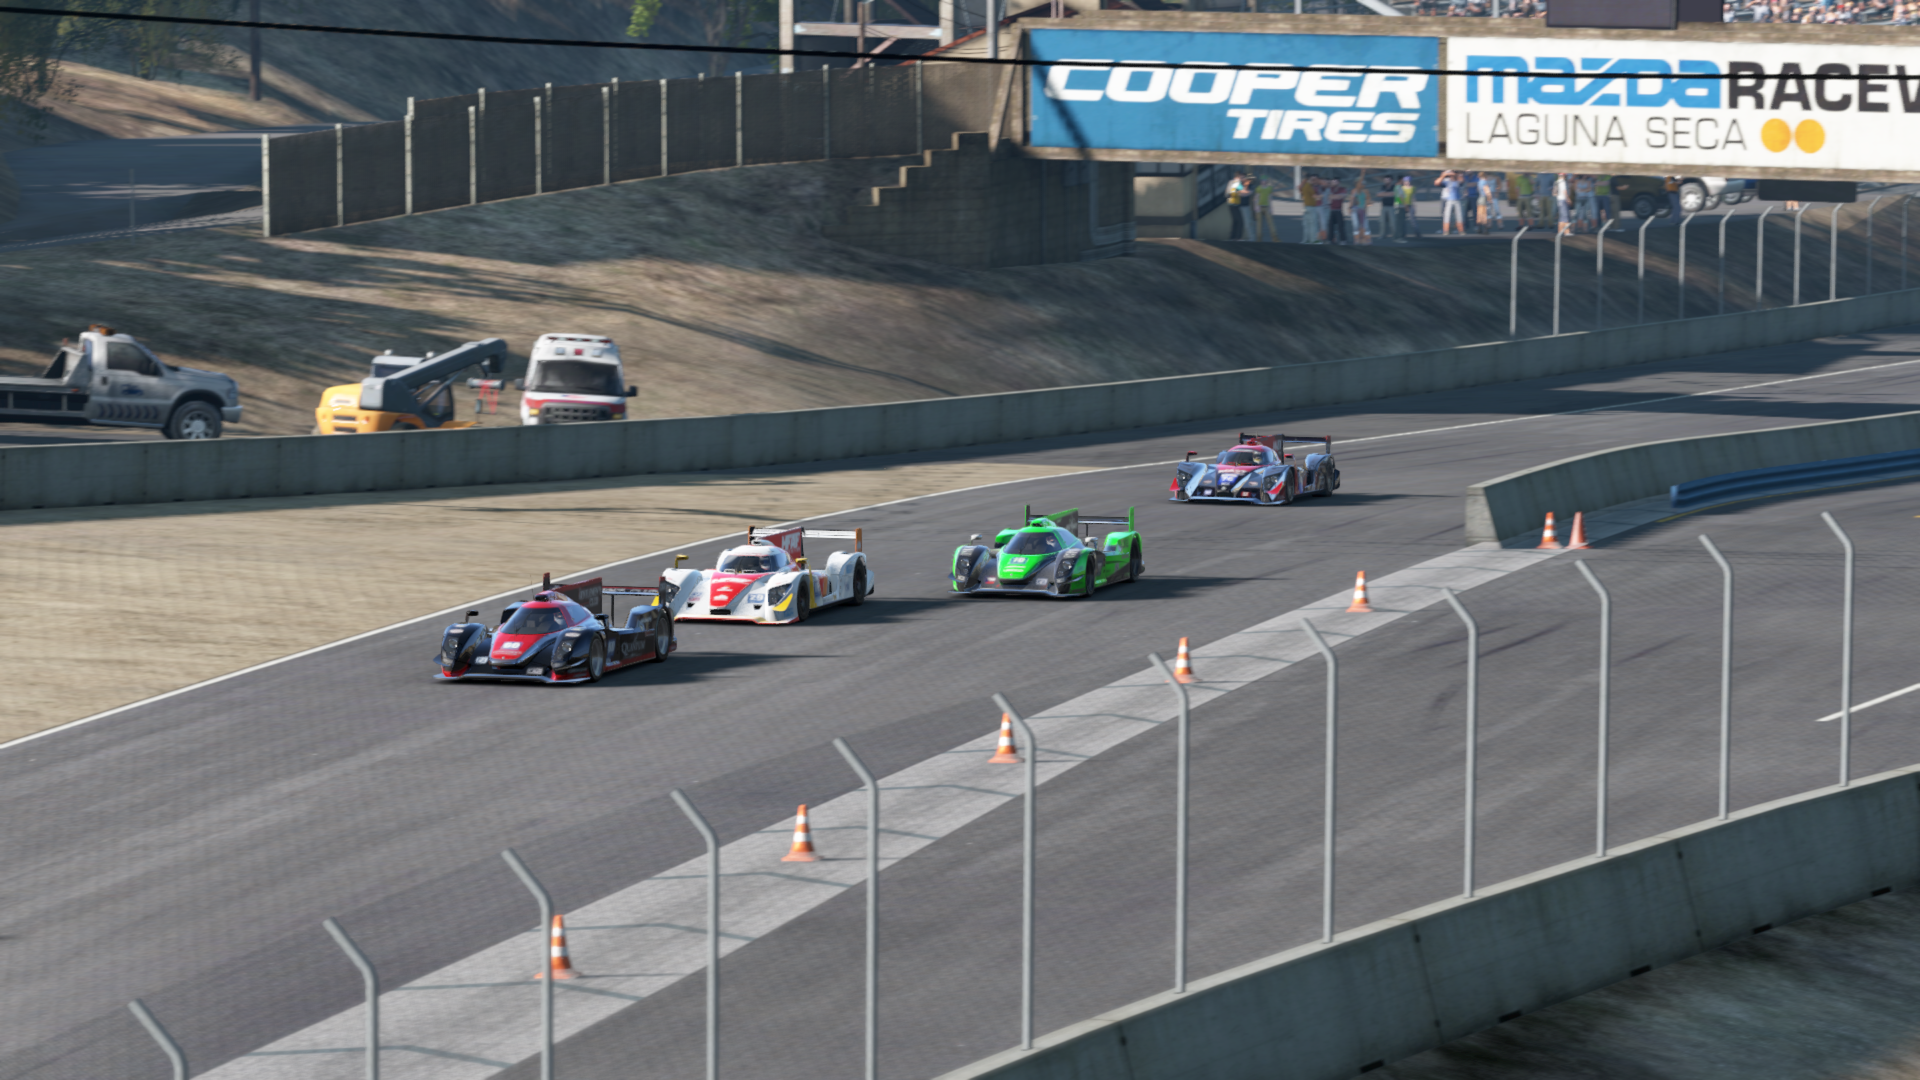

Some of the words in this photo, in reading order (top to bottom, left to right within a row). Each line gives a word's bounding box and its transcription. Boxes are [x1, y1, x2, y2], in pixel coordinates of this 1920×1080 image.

[1045, 59, 1429, 109] COOPER
[1226, 108, 1420, 144] TIRES
[1466, 112, 1626, 148] LAGUNA
[1646, 117, 1746, 150] SECA
